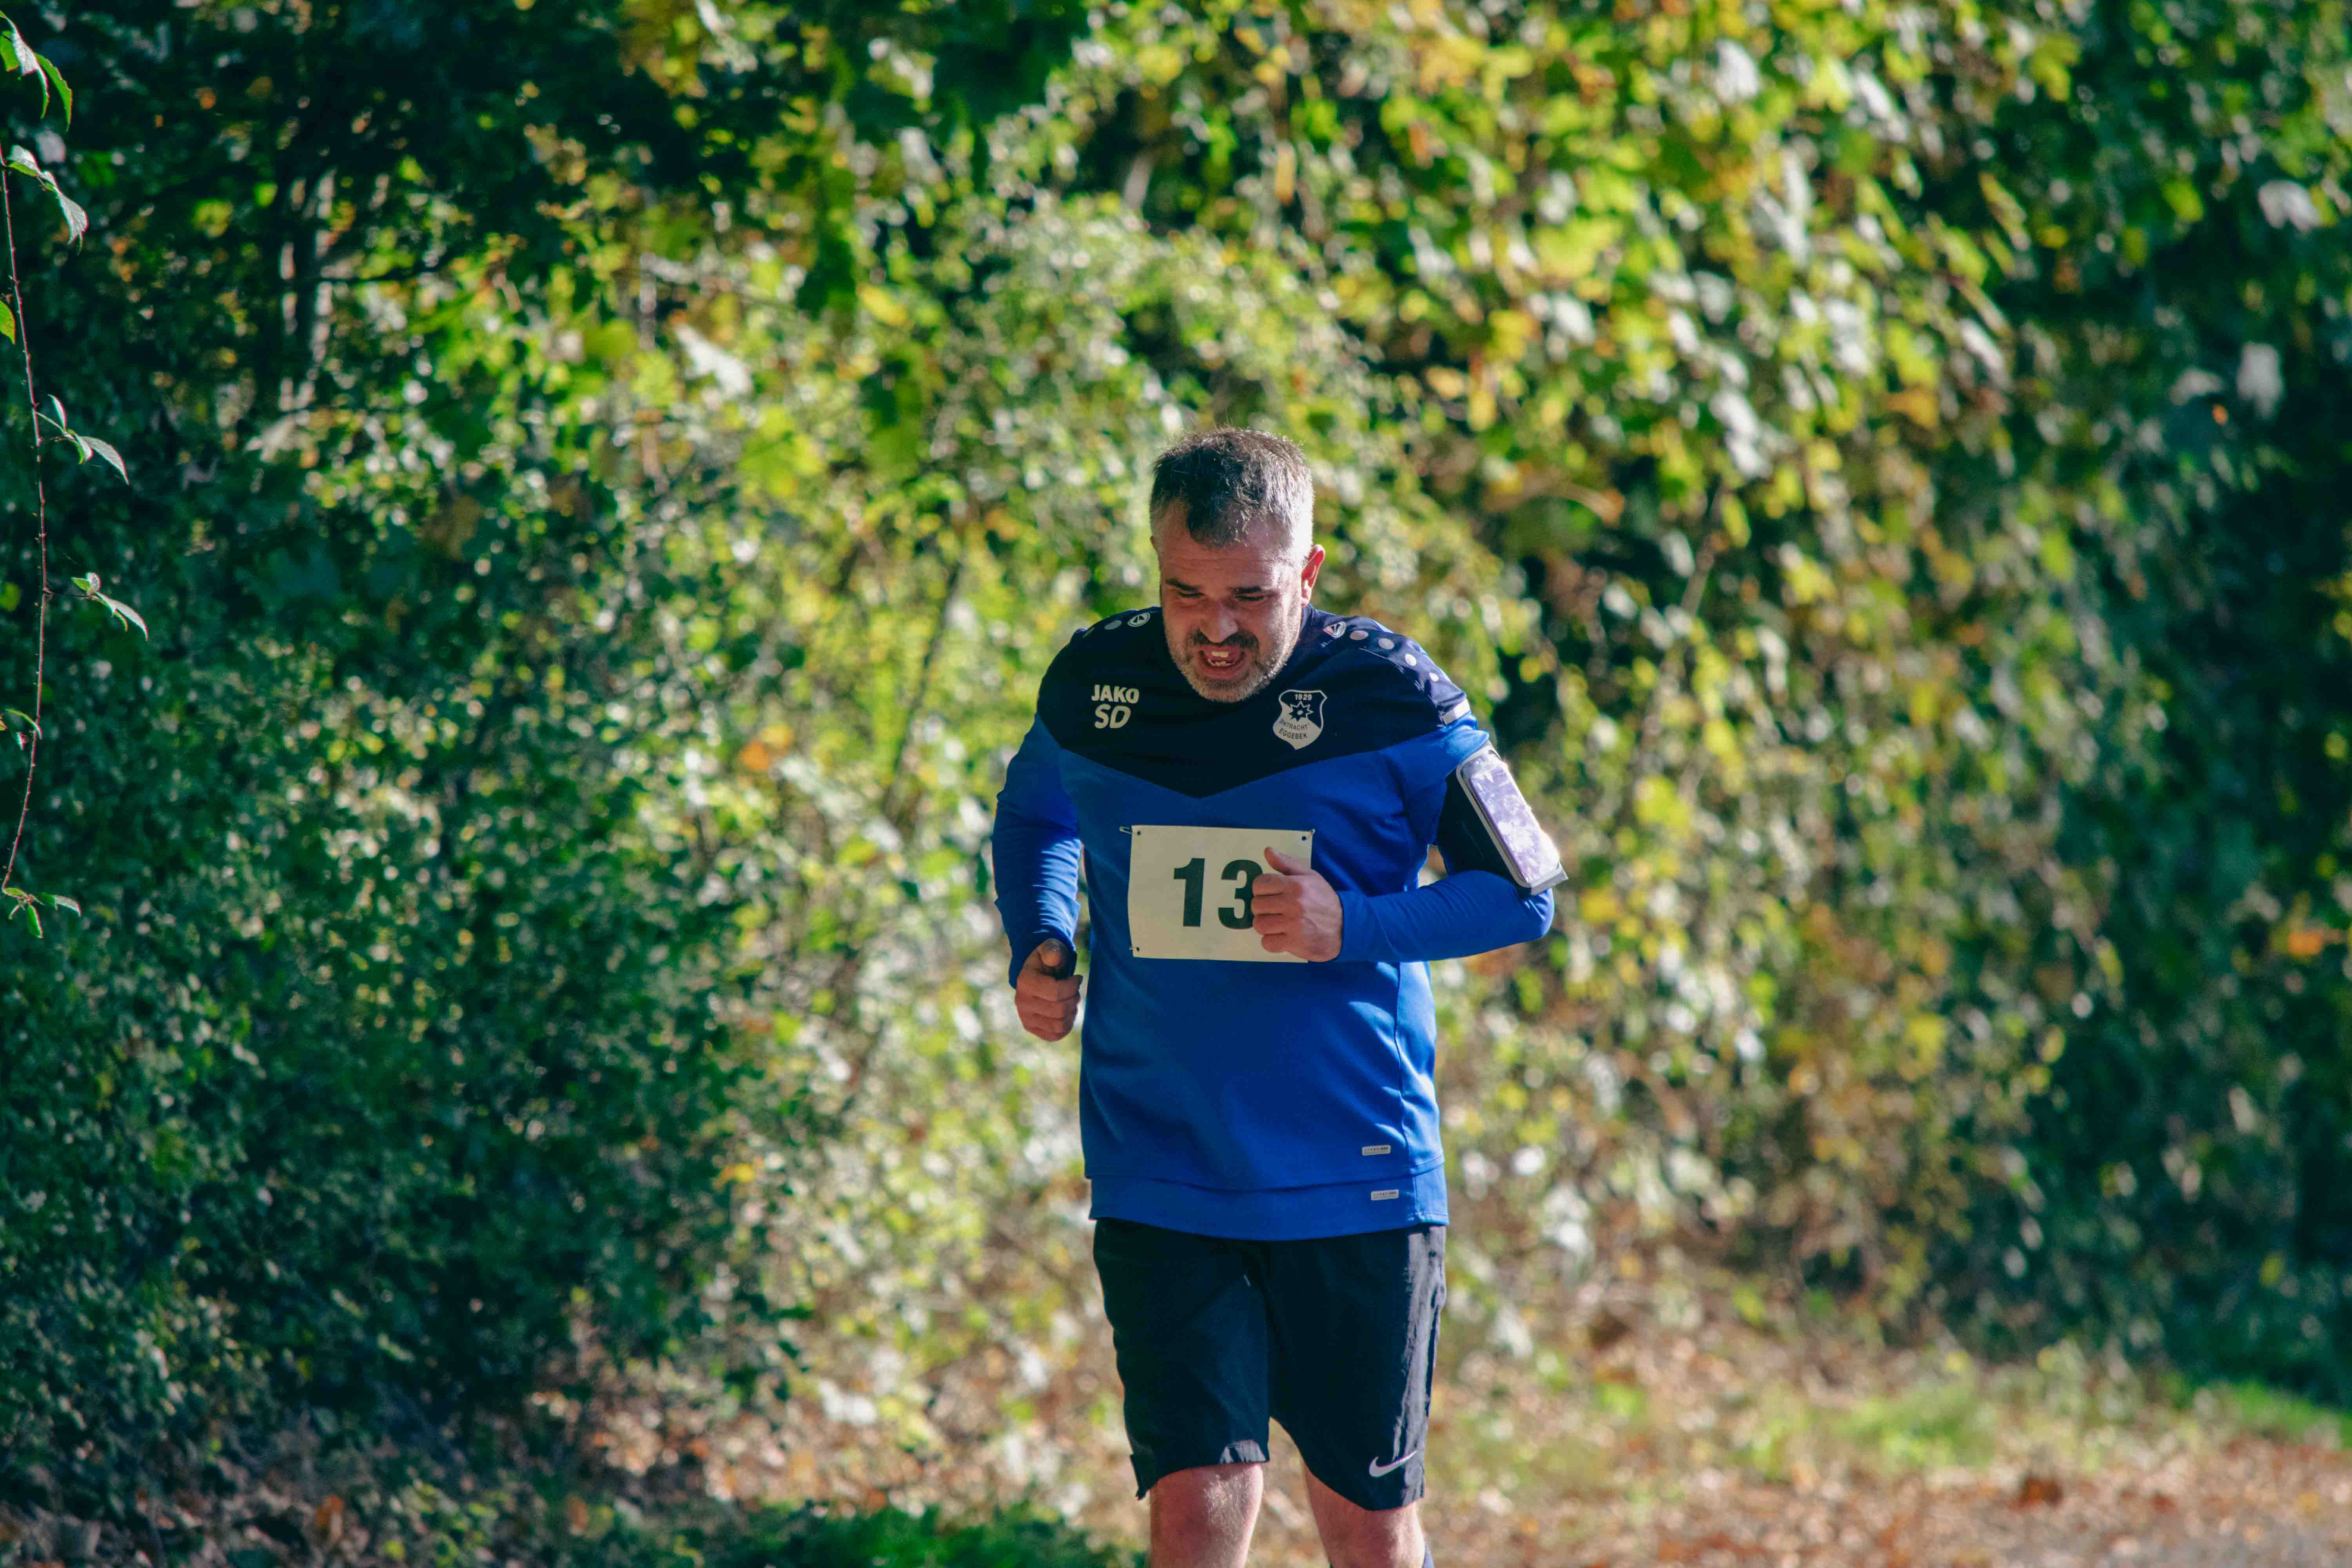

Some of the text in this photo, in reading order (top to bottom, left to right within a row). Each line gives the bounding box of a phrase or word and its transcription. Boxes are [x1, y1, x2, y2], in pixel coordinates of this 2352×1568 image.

[1091, 684, 1140, 704] JAKO
[1094, 704, 1131, 729] SD
[1174, 858, 1263, 929] 13
